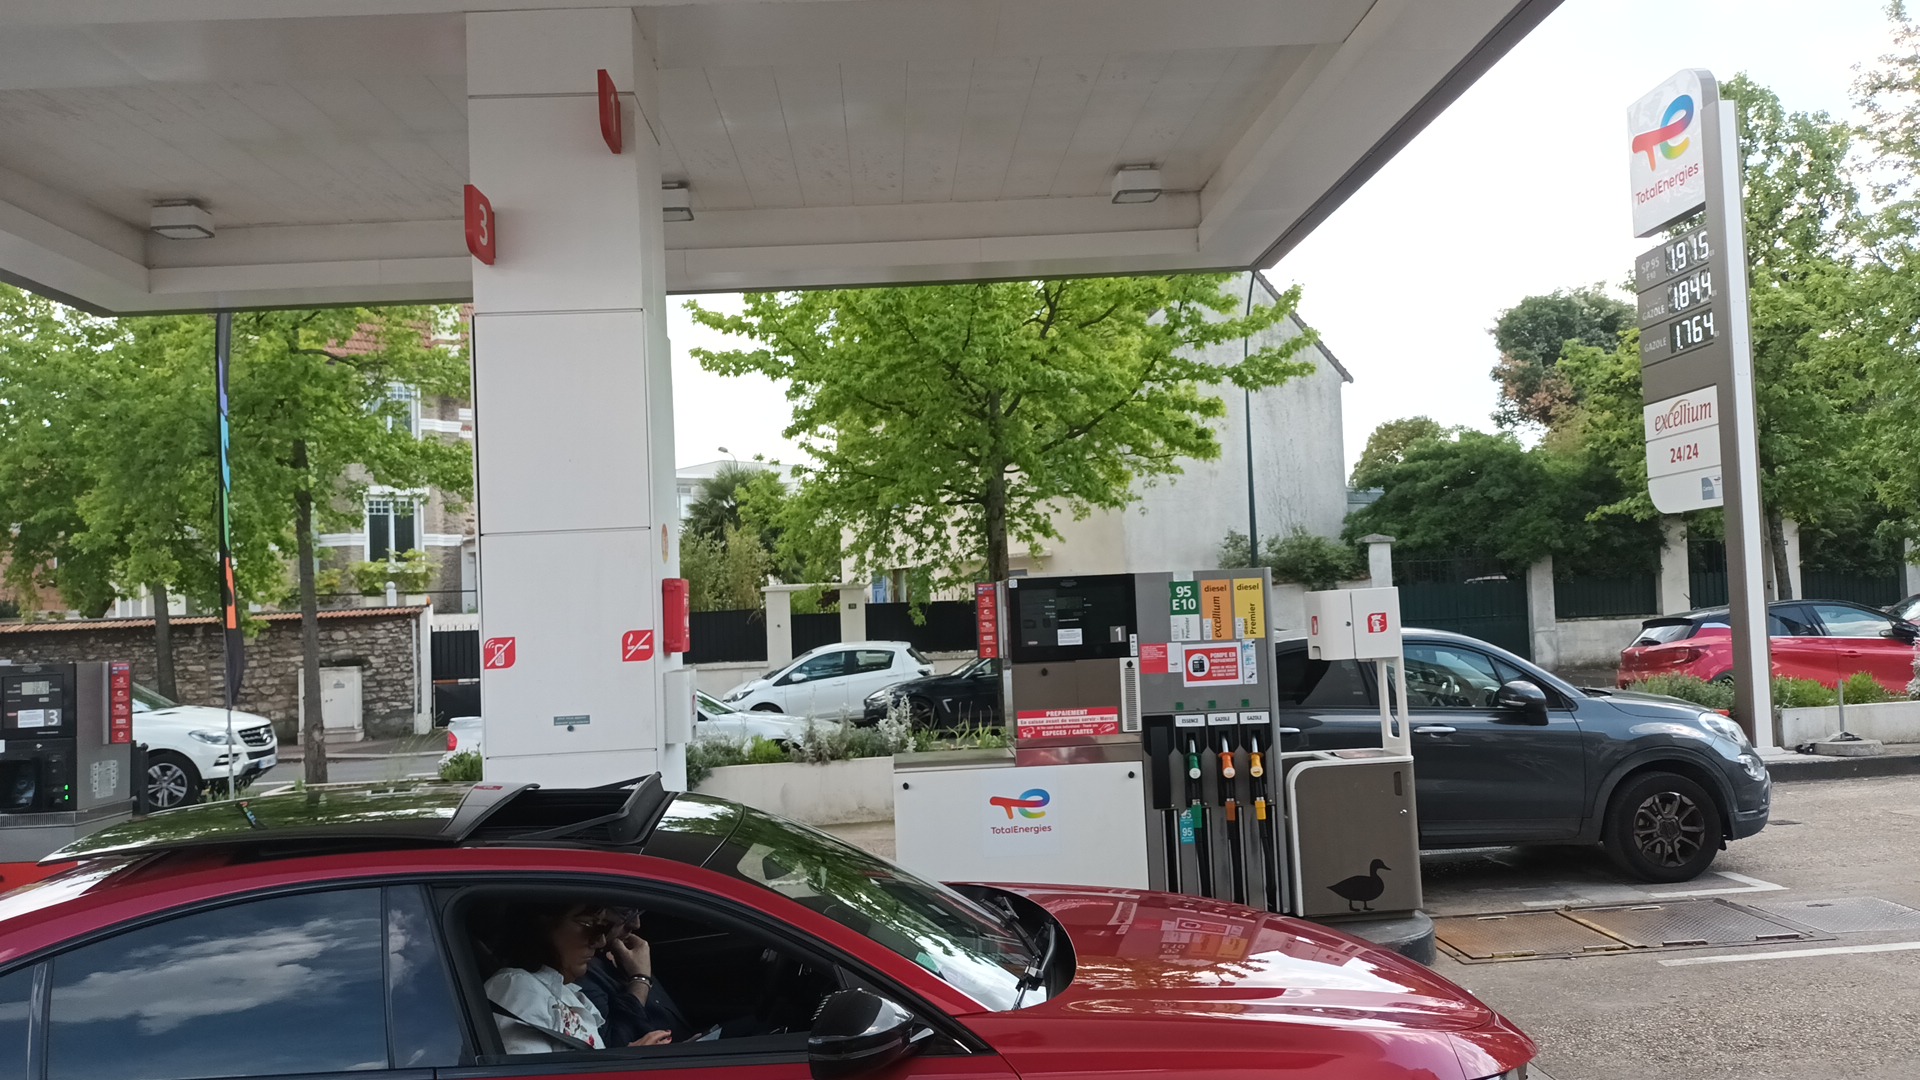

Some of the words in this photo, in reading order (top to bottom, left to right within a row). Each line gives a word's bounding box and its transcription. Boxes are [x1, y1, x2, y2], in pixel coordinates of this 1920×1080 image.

[610, 92, 617, 133] 1
[1635, 163, 1699, 206] TotalEnergies
[479, 203, 488, 246] 3
[1642, 305, 1665, 321] GAZOLE
[1644, 337, 1667, 352] GAZOLE
[1655, 401, 1712, 432] excellium
[1670, 443, 1699, 464] 24/24
[1176, 585, 1192, 598] 95
[1204, 584, 1227, 592] diesel
[1236, 583, 1259, 591] diesel
[1172, 598, 1197, 611] E10
[1212, 596, 1222, 638] excellium
[1248, 603, 1256, 635] Premier
[1115, 626, 1121, 641] 1
[47, 709, 58, 726] 3
[990, 824, 1052, 834] TotalEnergies
[1182, 827, 1193, 836] 95
